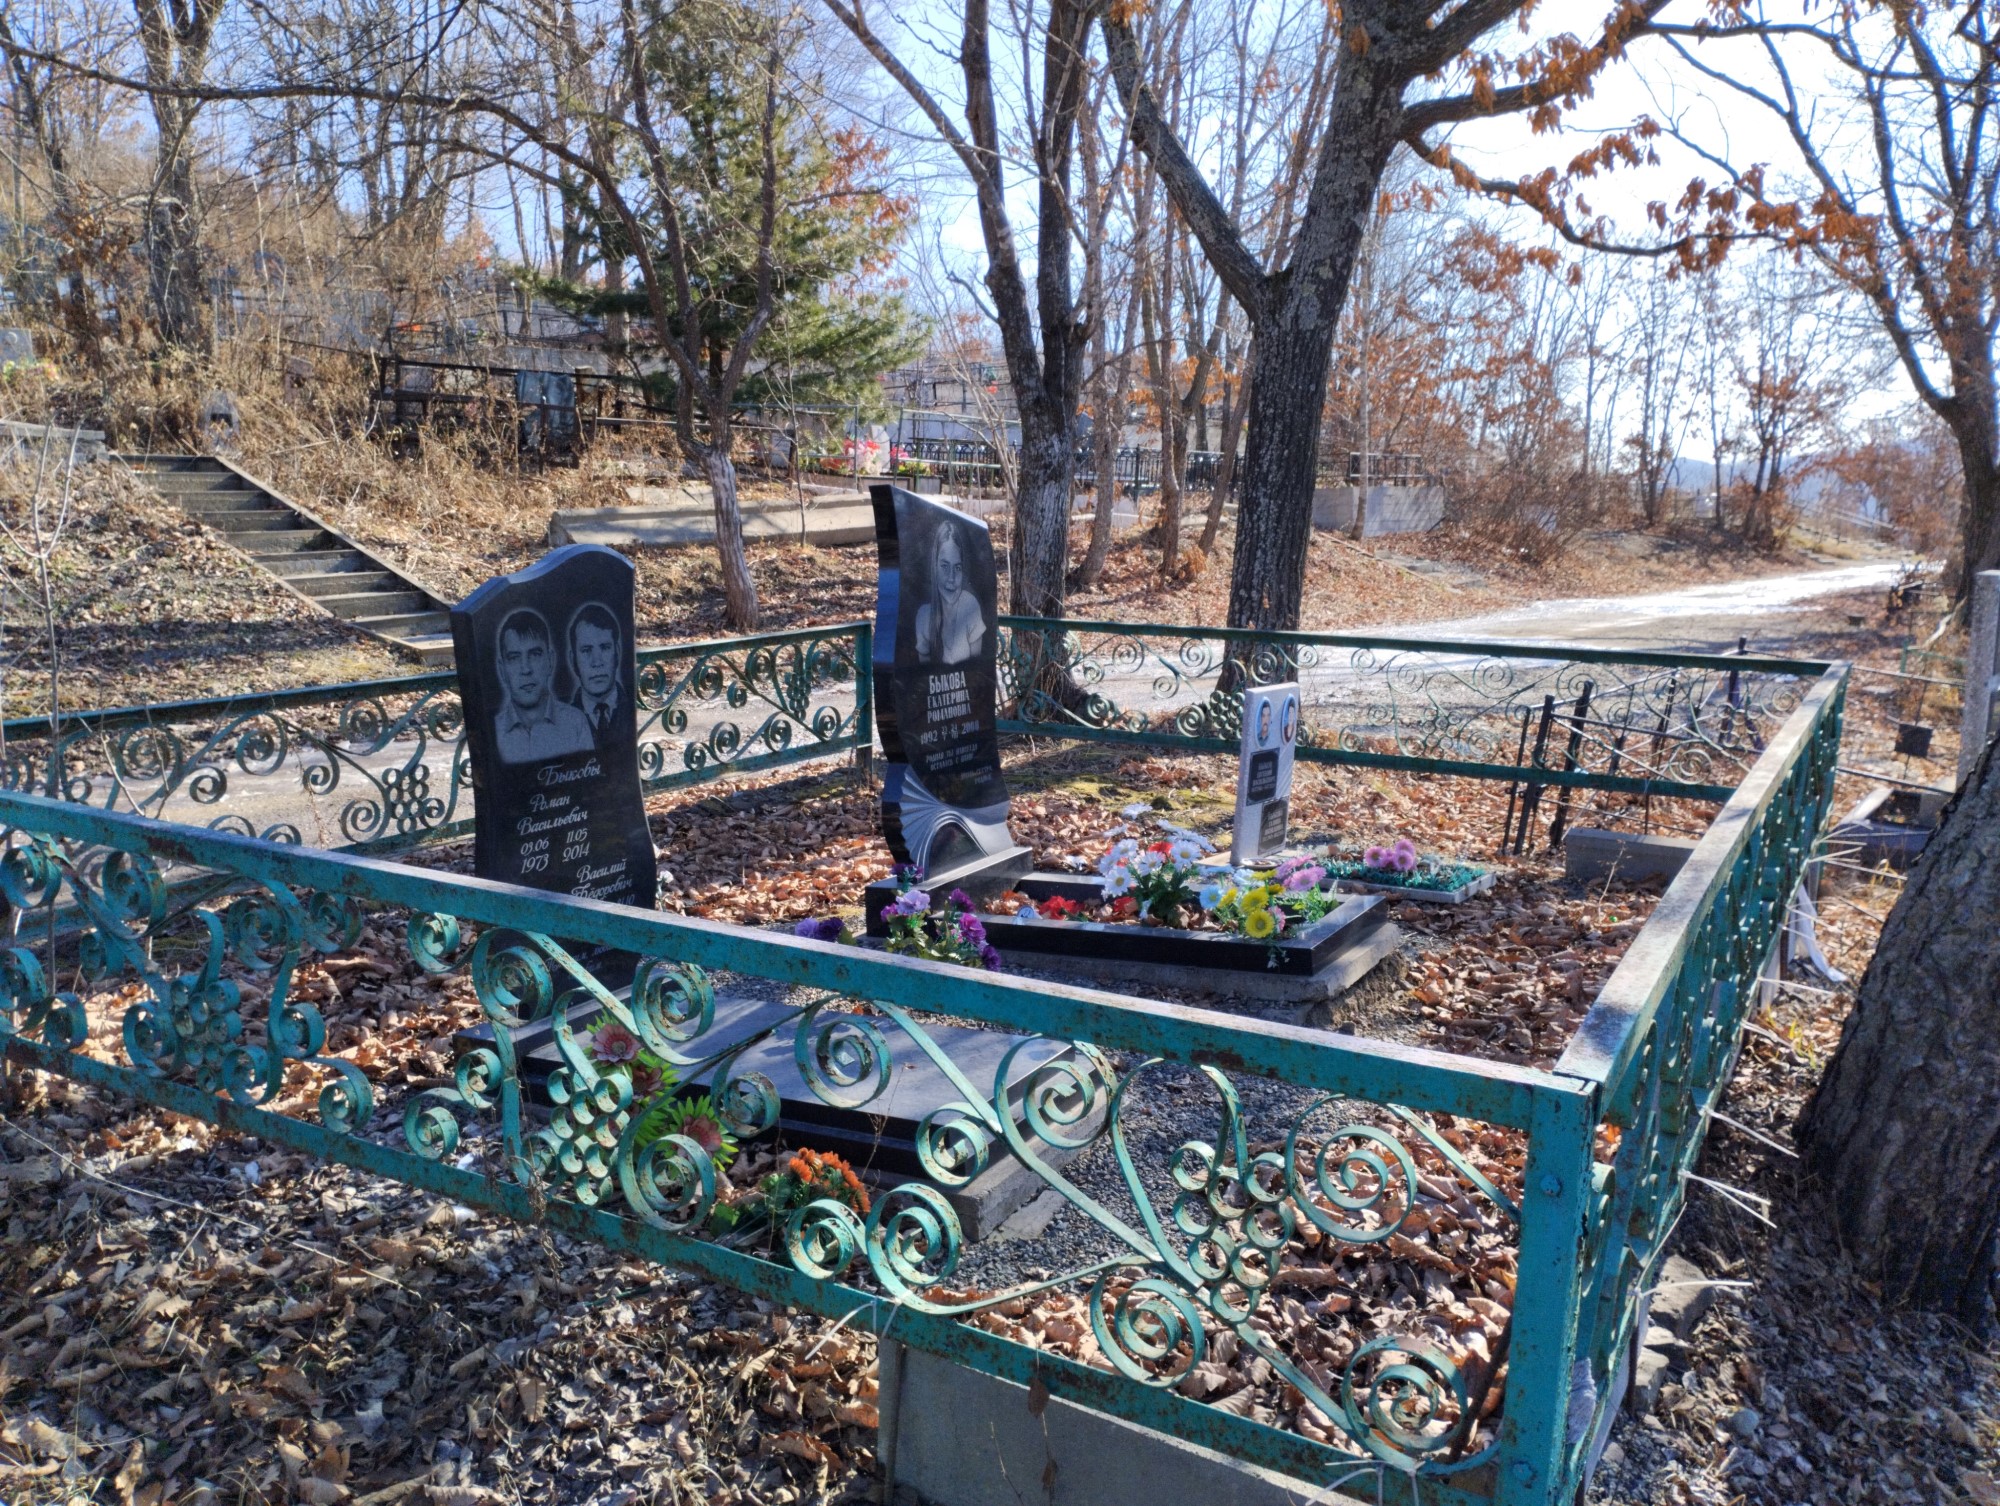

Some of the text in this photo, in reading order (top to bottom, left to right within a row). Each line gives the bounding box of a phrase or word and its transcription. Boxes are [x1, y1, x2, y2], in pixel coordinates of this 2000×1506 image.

[929, 670, 966, 695] БЫКОВА
[927, 689, 970, 709] ЕКАТЕРИНА
[927, 702, 971, 723] РОМАНОВНА
[920, 730, 938, 744] 1992
[537, 757, 602, 786] Быковы
[529, 793, 570, 812] Роман
[517, 806, 588, 836] Васильевич
[520, 828, 588, 857] 03.06 11.05
[520, 841, 591, 874] 1973 2014
[576, 858, 627, 883] Василий
